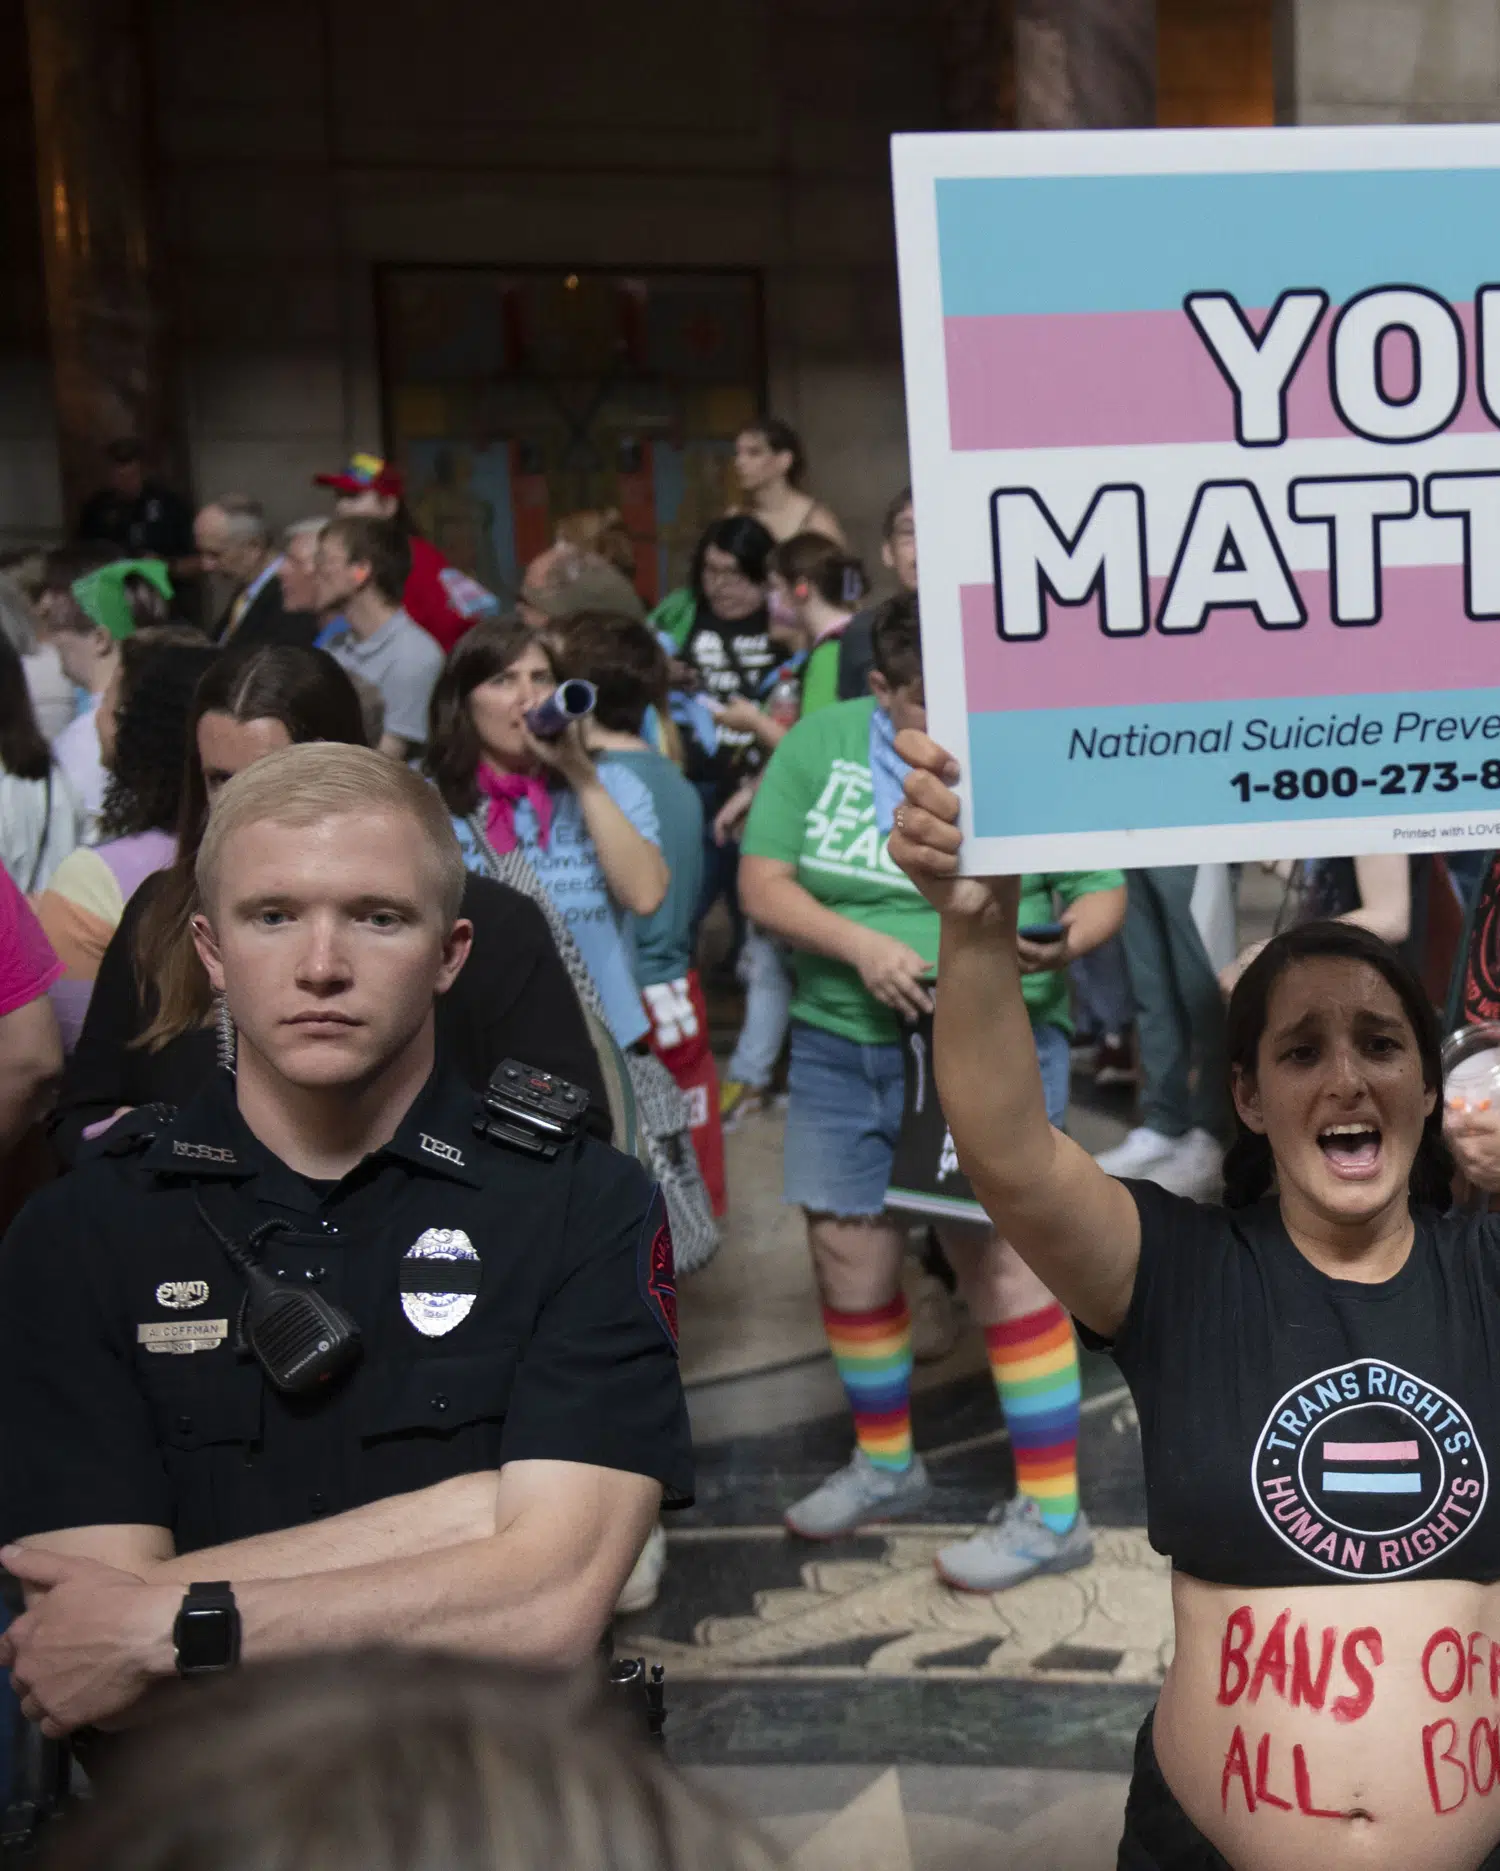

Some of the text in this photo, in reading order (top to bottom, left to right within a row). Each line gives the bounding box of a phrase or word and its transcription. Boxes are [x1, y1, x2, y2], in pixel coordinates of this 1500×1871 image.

[1067, 720, 1233, 760] National
[1242, 713, 1383, 751] Suicide
[1393, 828, 1436, 840] Printed
[1441, 826, 1464, 837] with
[160, 1281, 204, 1299] SWAT
[163, 1324, 219, 1336] COFFMAN
[1267, 1366, 1471, 1454] TRANS RIGHTS
[1263, 1475, 1480, 1569] HUMAN RIGHTS
[1216, 1605, 1385, 1724] BANS
[1220, 1725, 1350, 1818] ALL
